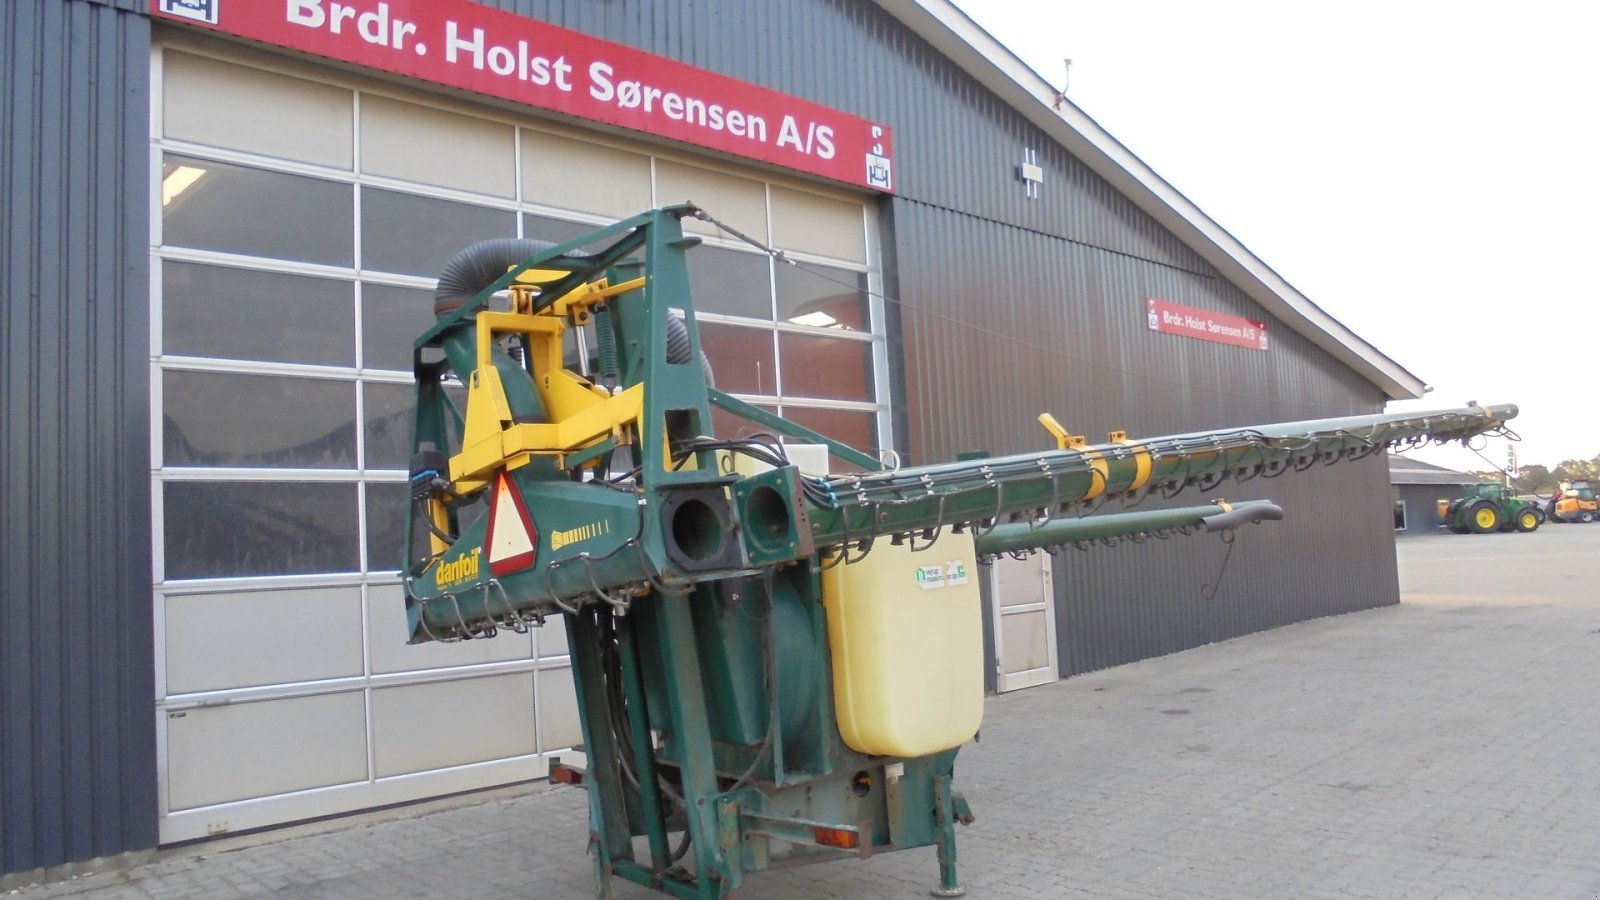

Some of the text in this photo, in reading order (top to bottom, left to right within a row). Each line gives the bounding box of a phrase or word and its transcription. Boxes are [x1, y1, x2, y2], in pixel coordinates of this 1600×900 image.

[286, 0, 836, 160] Brdr. Holst Sørensen A/S
[1163, 310, 1184, 327] Brdr.
[1185, 315, 1206, 331] Holst
[436, 547, 479, 585] danfoil
